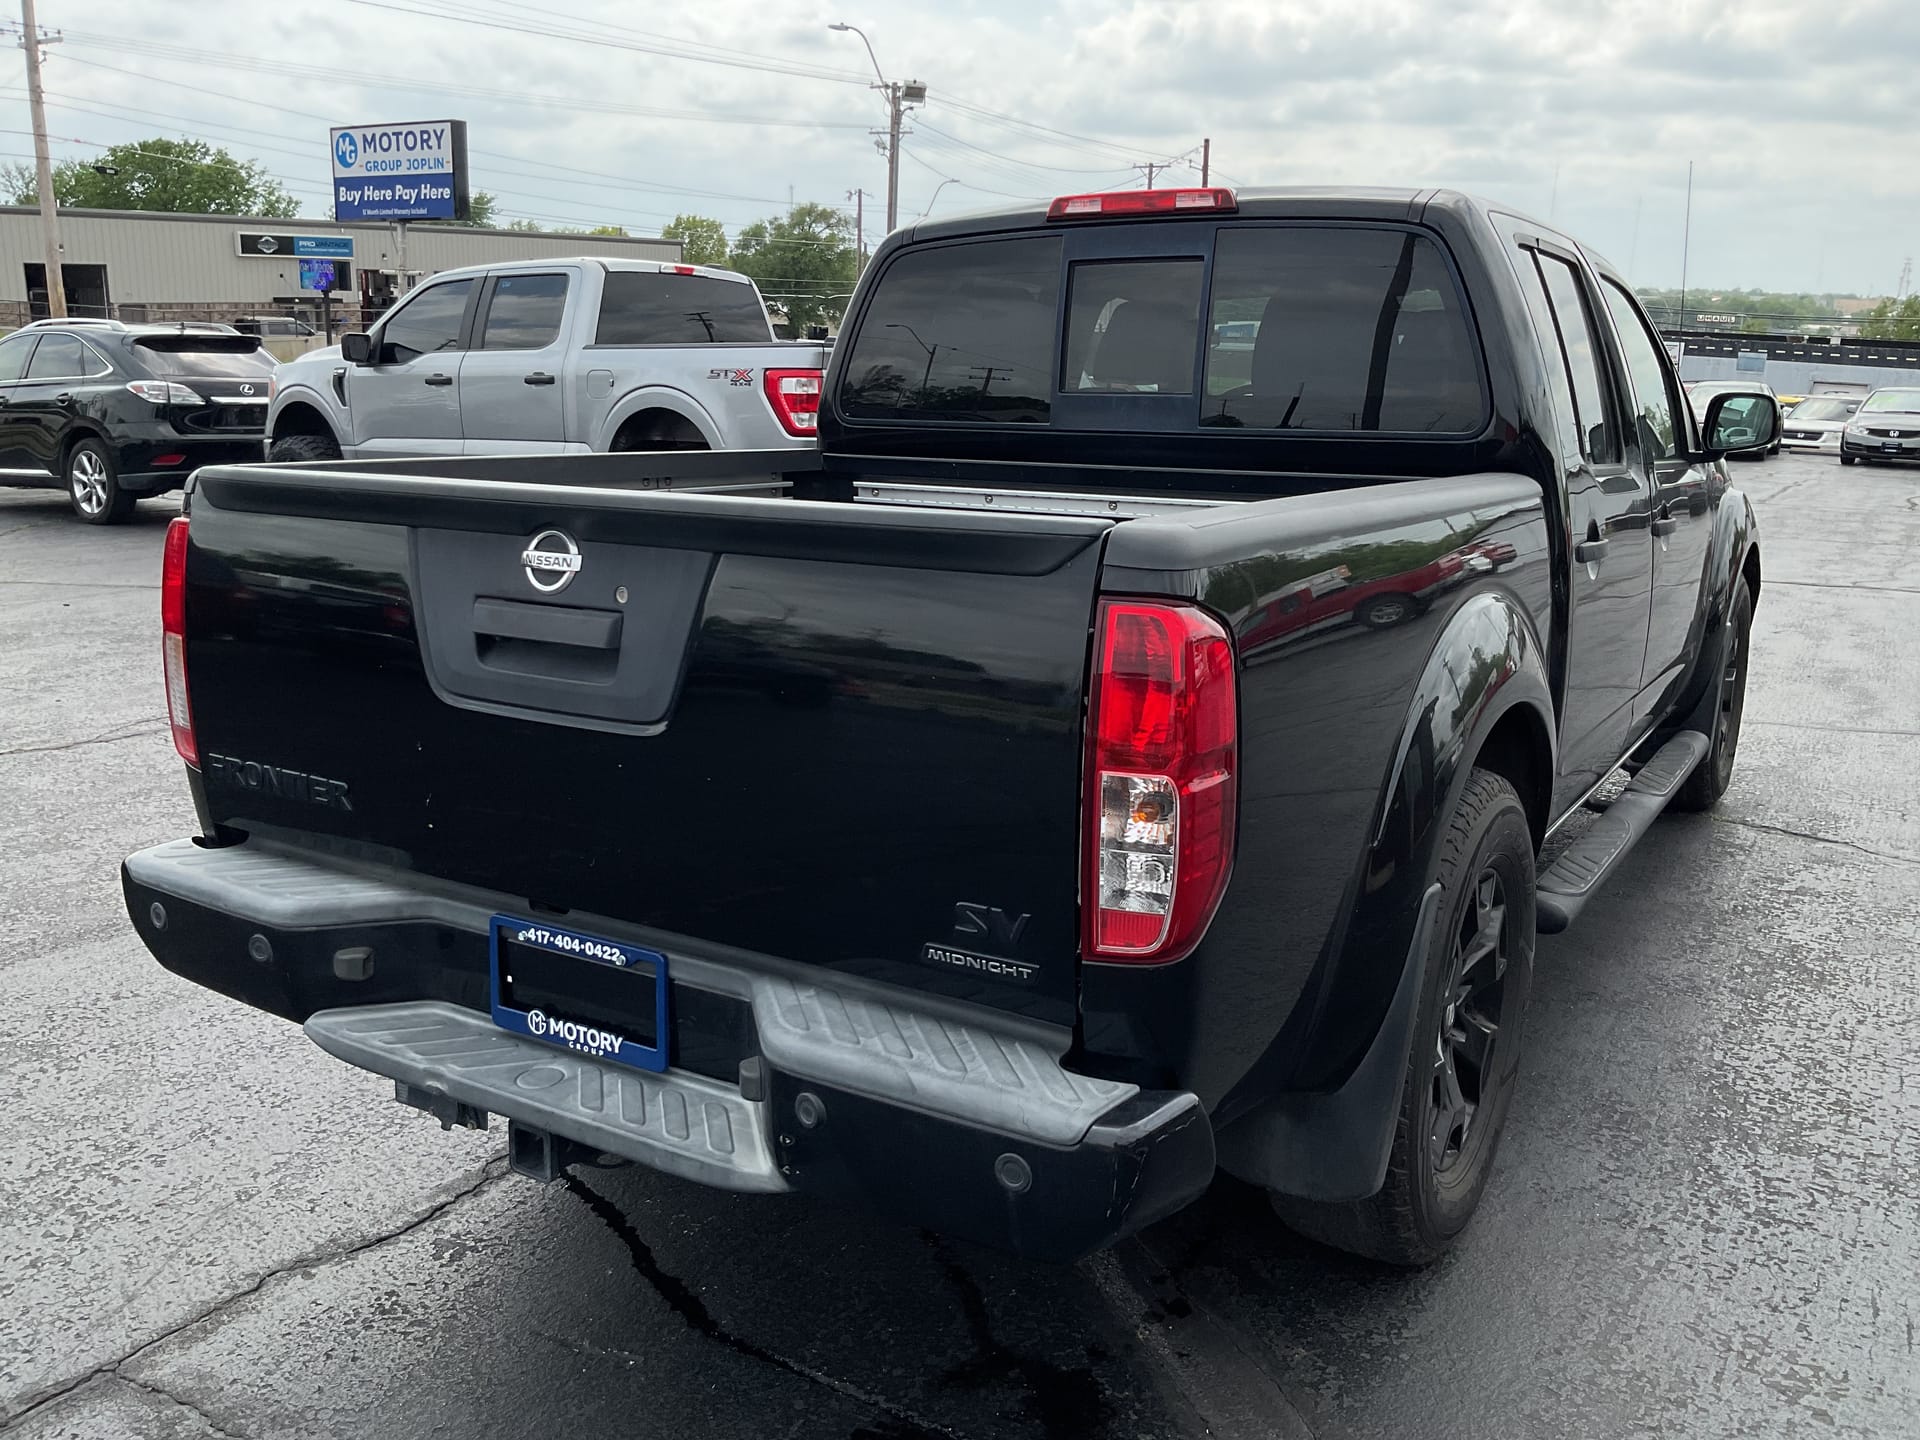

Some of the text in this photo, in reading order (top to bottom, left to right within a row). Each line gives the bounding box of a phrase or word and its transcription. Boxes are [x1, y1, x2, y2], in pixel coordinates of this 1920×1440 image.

[362, 128, 445, 154] MOTORY
[365, 157, 444, 172] GROUP JOPLIN
[339, 183, 451, 206] Buy Here Pay Here
[707, 367, 754, 382] STX
[524, 553, 573, 568] NISSAN
[208, 752, 353, 812] FRONTIER
[954, 901, 1031, 943] SV
[927, 948, 1032, 979] MIDNIGHT
[549, 1017, 623, 1054] MOTORY
[568, 1040, 604, 1056] GROUP
